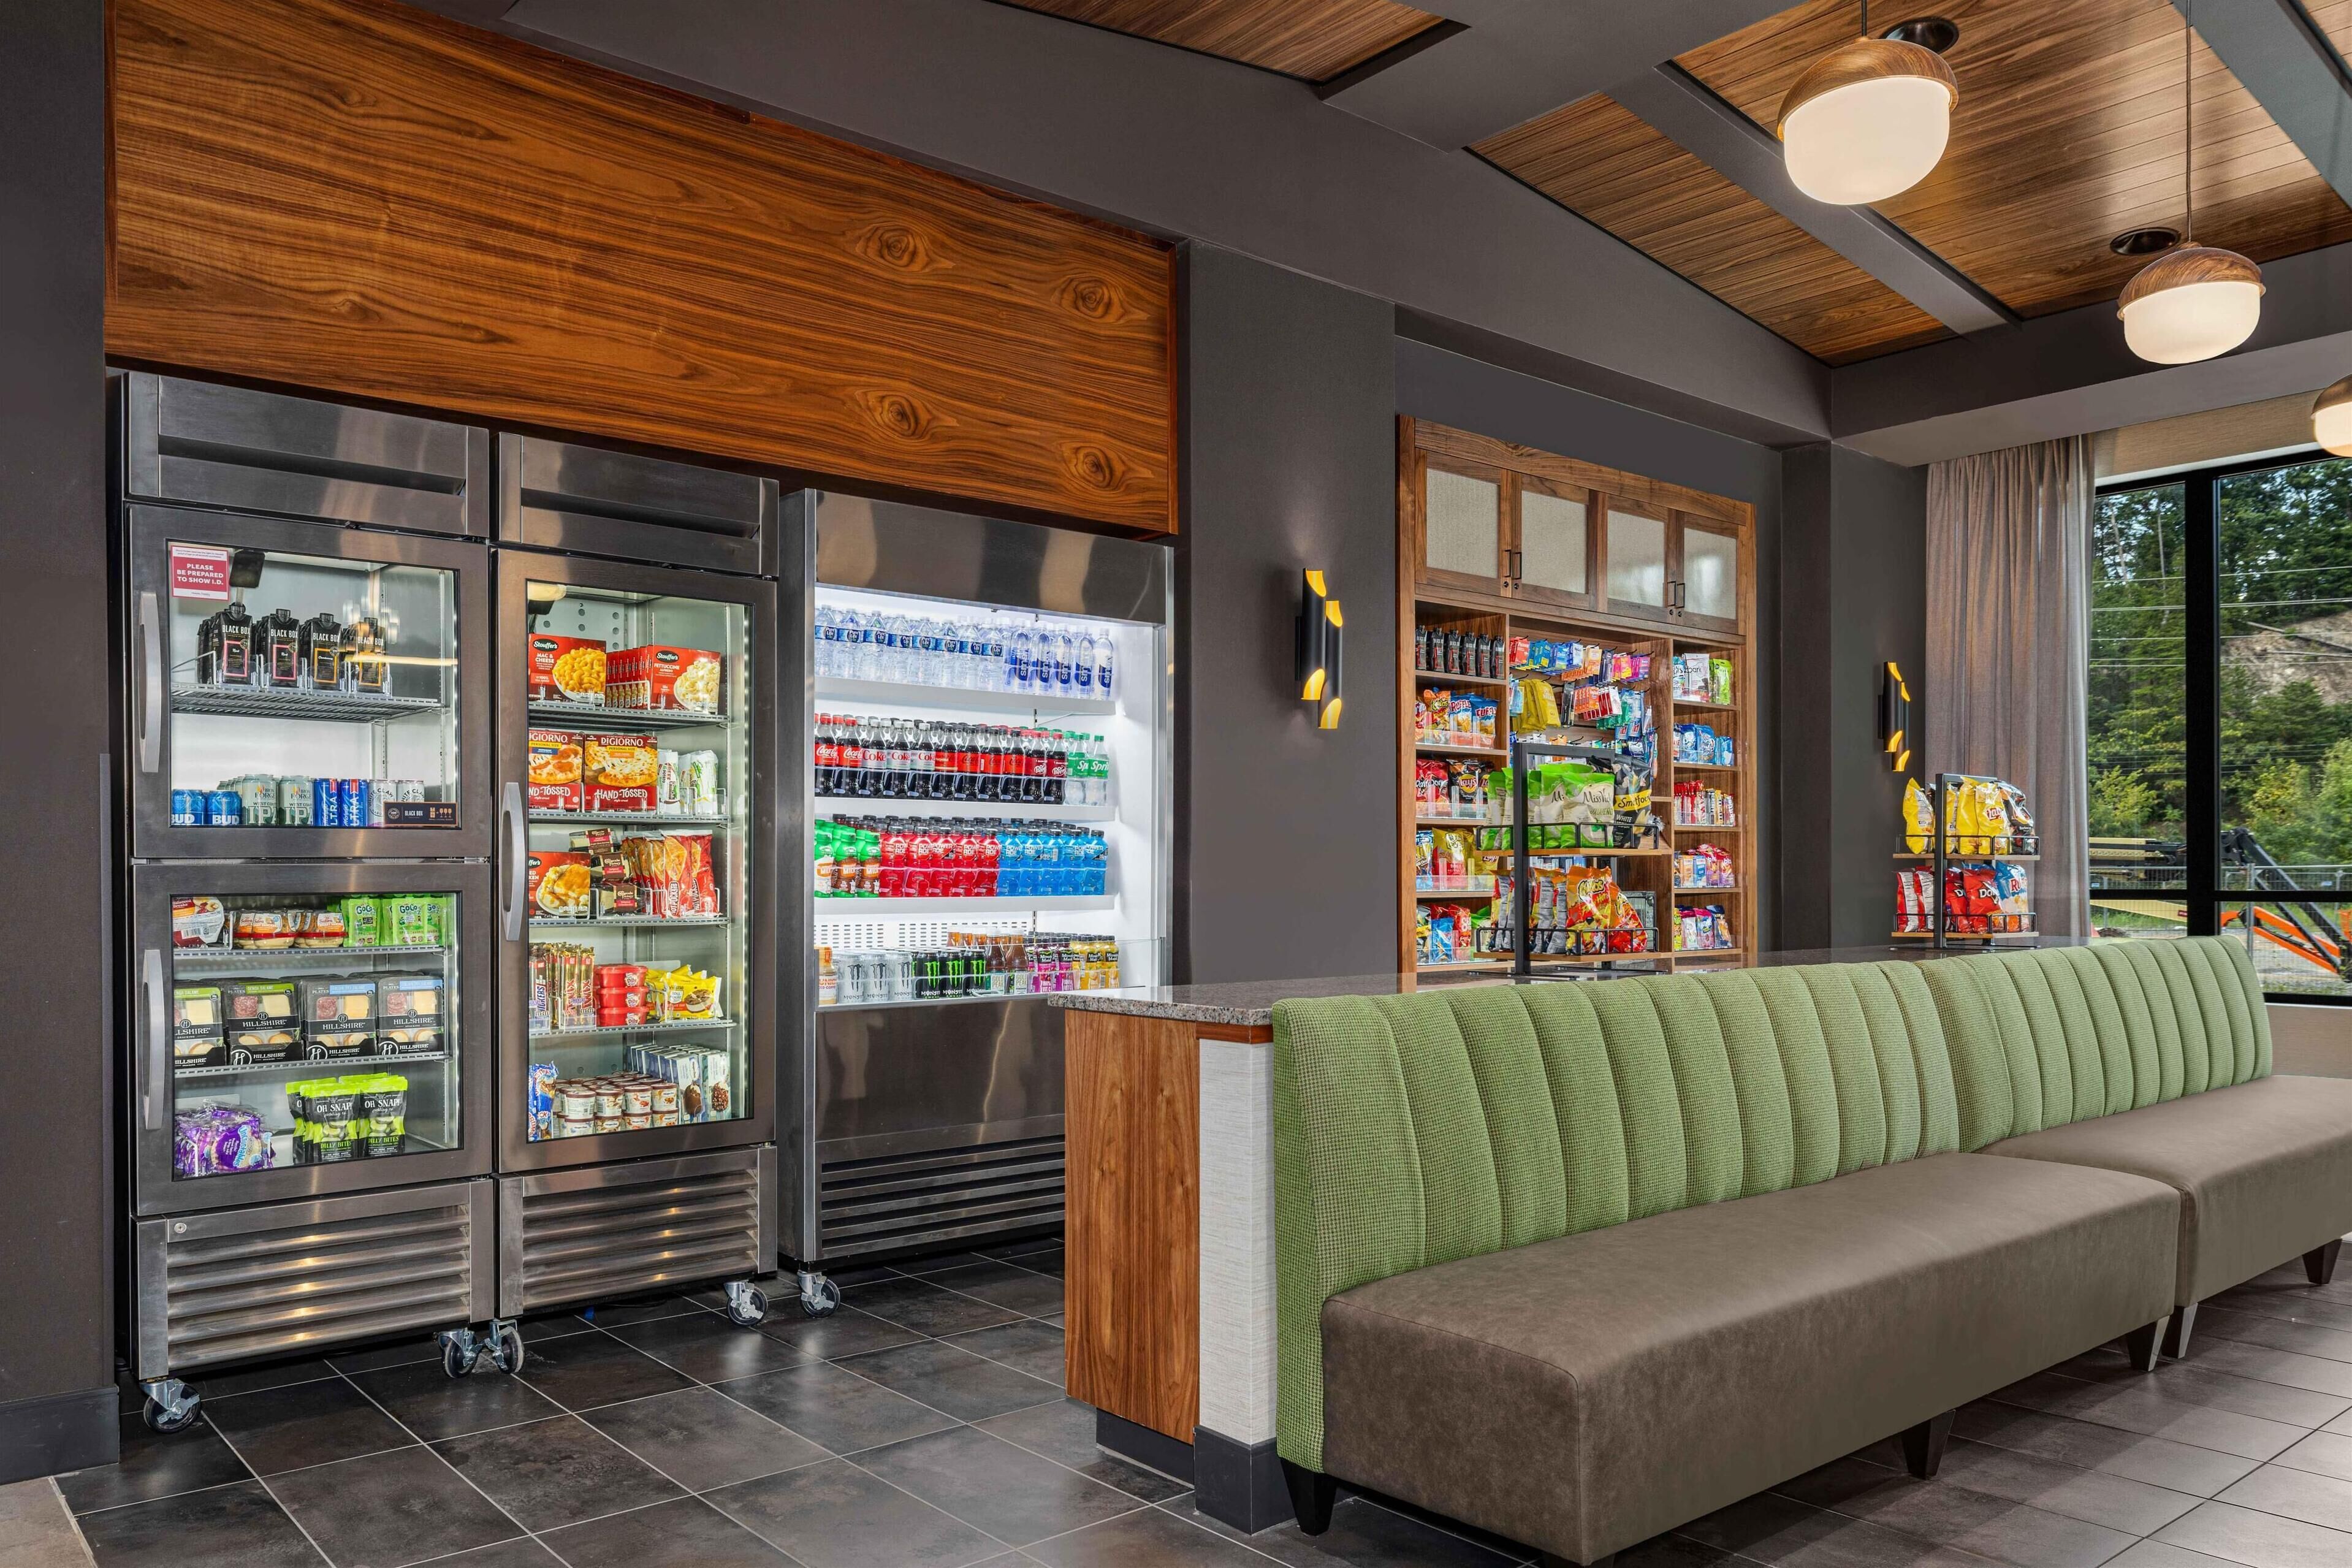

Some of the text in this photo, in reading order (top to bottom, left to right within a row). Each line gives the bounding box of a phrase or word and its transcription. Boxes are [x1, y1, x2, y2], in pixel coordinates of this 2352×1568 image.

[271, 629, 286, 637] BLACK
[313, 633, 328, 641] BLACK
[862, 750, 886, 761] Coke
[1461, 778, 1476, 788] Lay's
[402, 791, 410, 802] HITE
[1583, 791, 1600, 803] Miss
[350, 797, 359, 825] LTRA
[213, 815, 239, 824] BUD
[1616, 814, 1632, 823] WHITE
[330, 1102, 352, 1111] SNAP!
